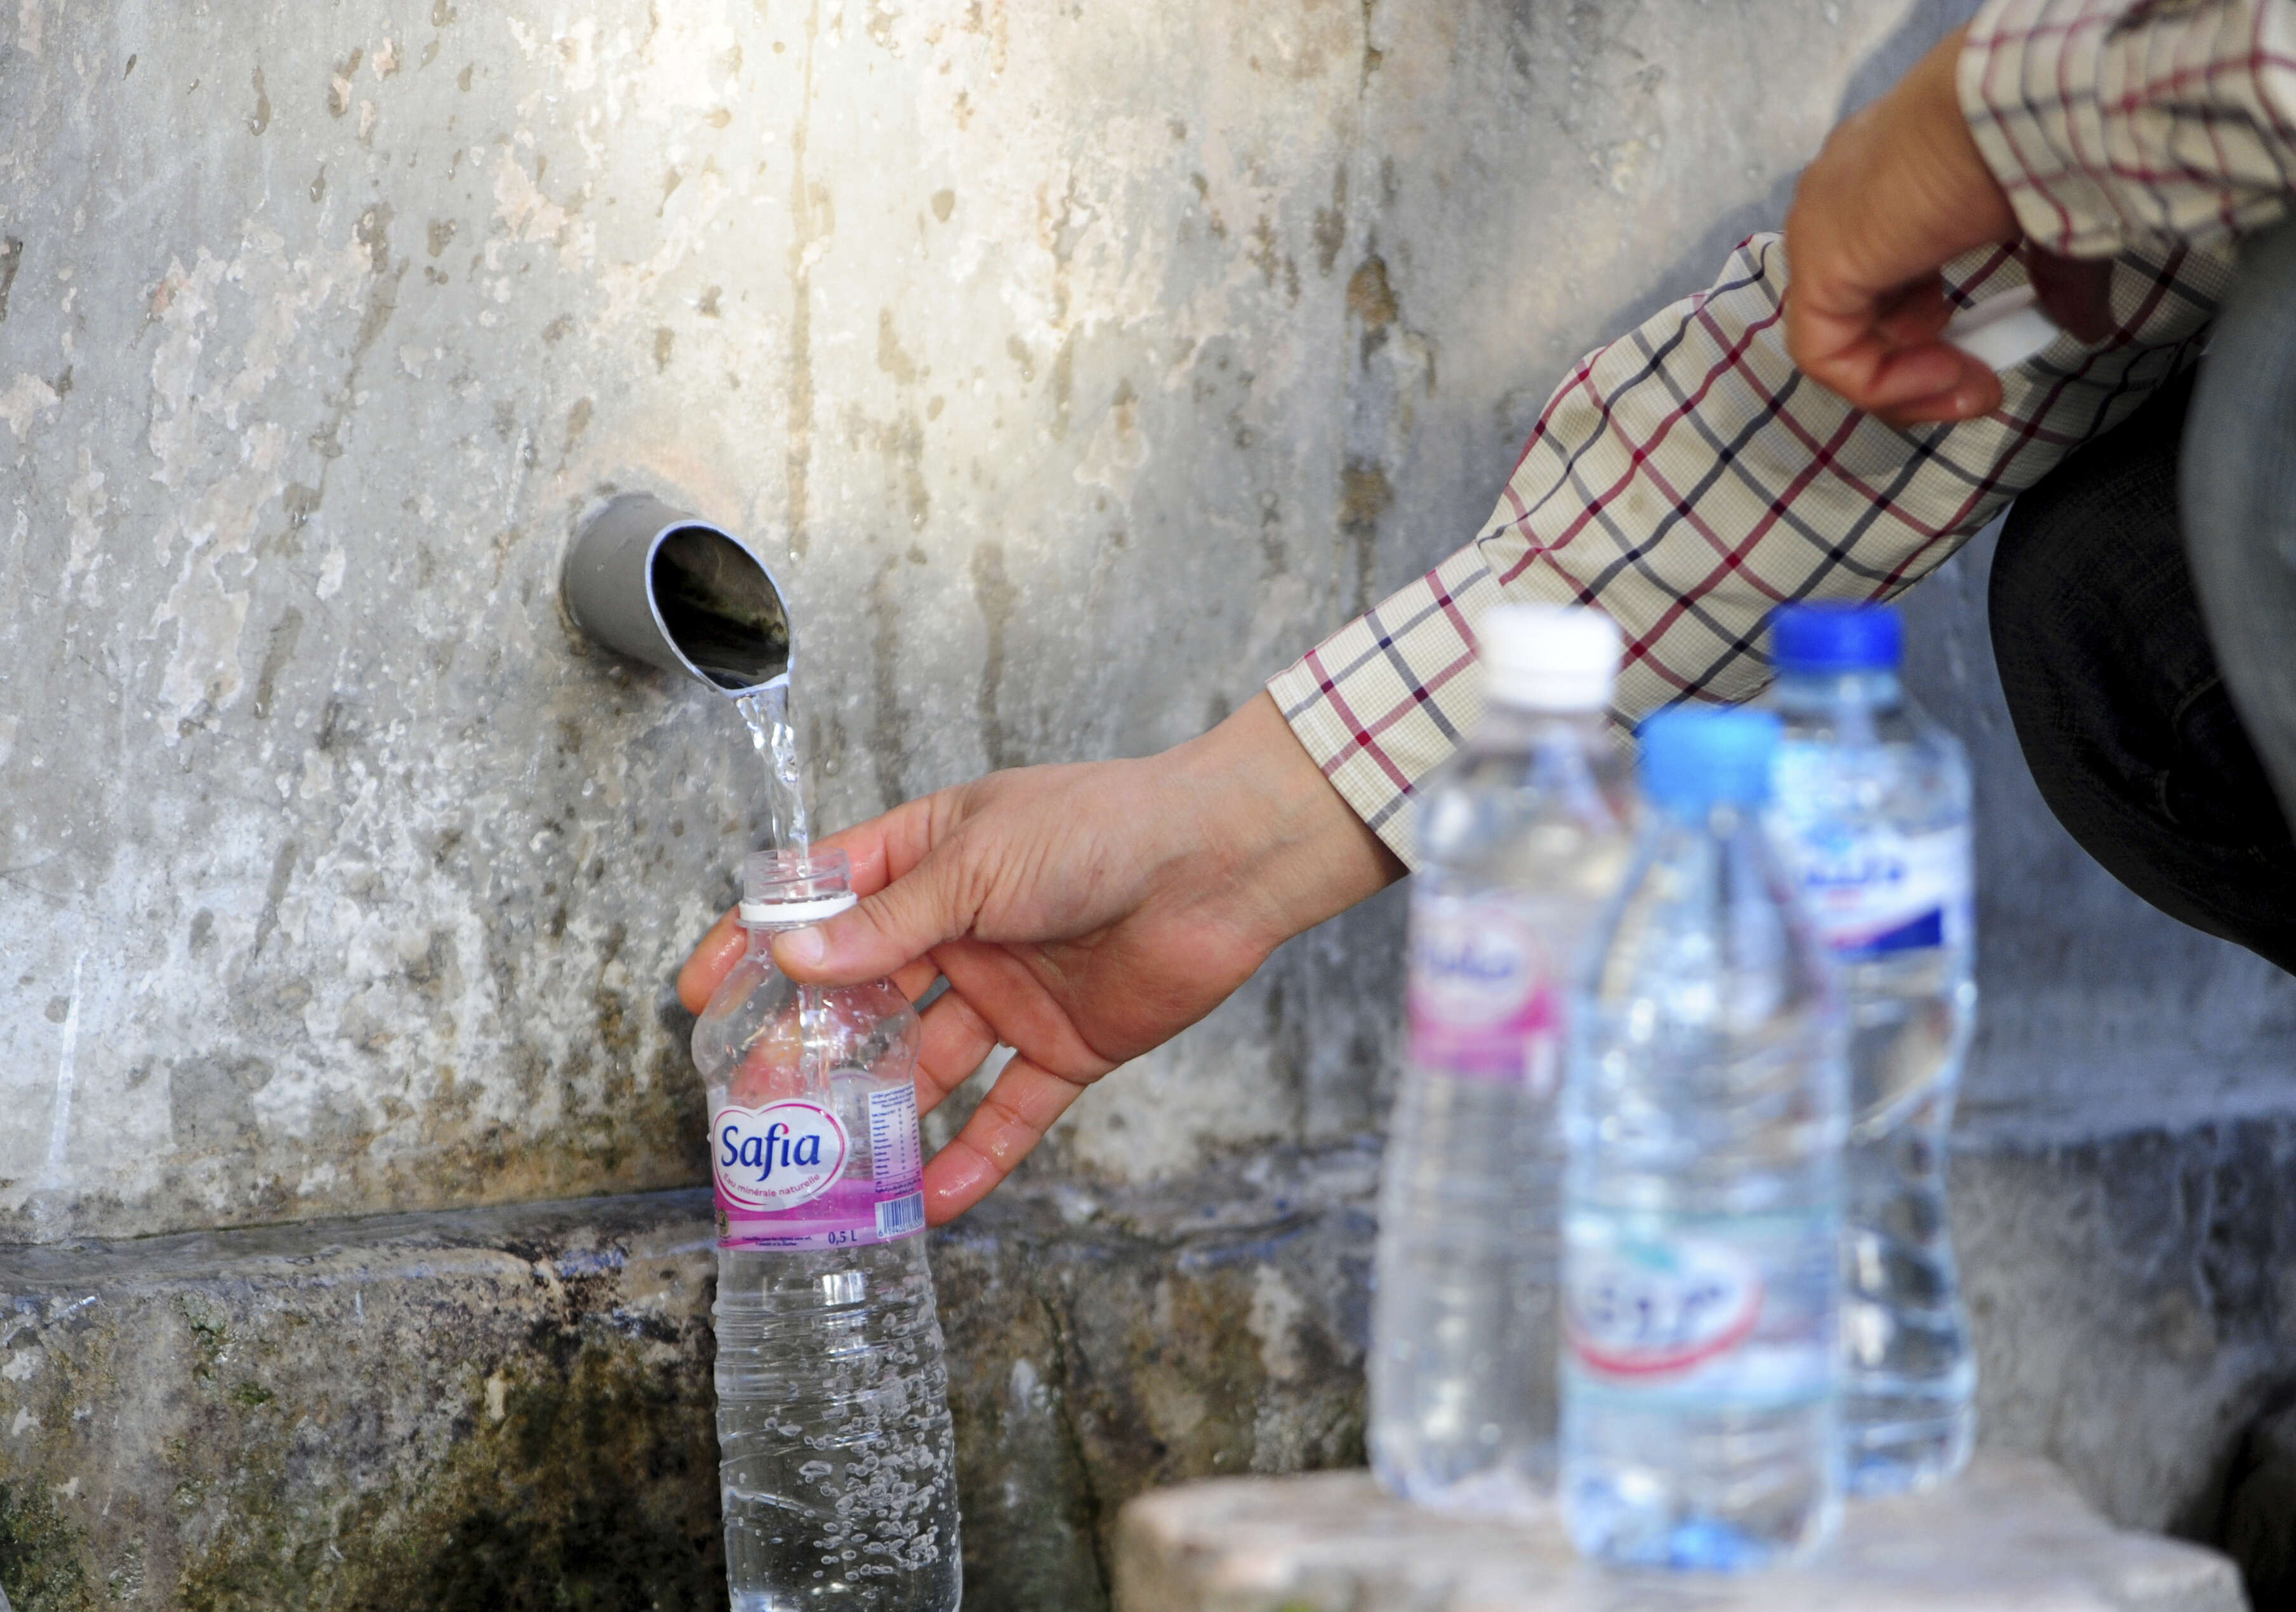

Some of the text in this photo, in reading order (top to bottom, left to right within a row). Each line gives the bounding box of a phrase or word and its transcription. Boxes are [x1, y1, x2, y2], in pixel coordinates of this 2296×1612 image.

[721, 1122, 821, 1182] Safia
[723, 1173, 820, 1197] Eau minérale naturelle
[828, 1230, 857, 1245] 0,5 L
